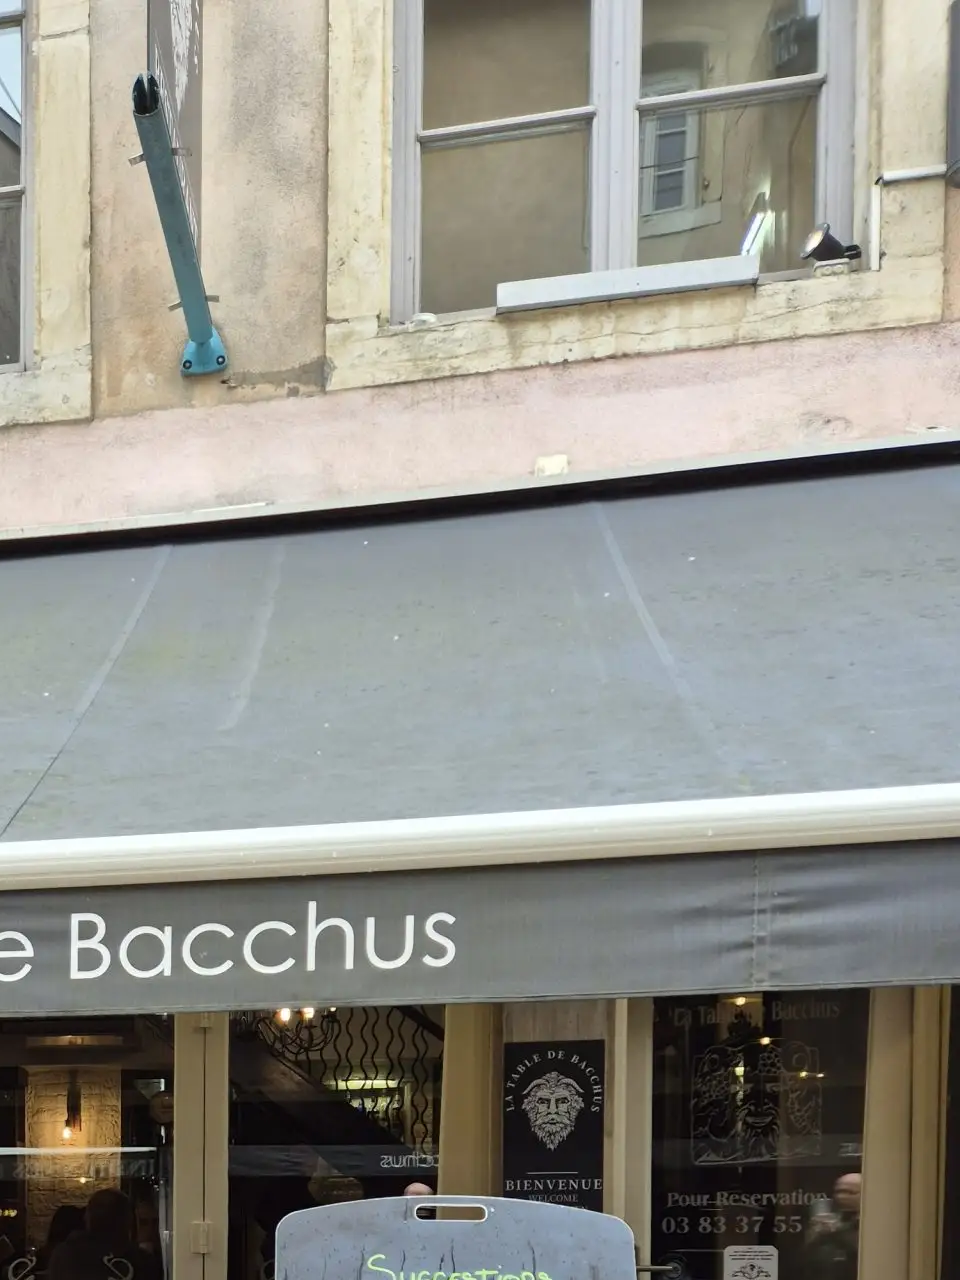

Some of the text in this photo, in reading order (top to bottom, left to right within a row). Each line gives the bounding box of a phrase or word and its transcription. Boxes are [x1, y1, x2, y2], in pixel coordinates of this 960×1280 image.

[69, 900, 456, 980] Bacchus
[505, 1050, 604, 1113] LA TABLE DE BACCHUS
[505, 1178, 603, 1192] BIENVENUE
[529, 1194, 578, 1203] WELCOME
[667, 1189, 828, 1208] Pour Reservation
[661, 1216, 690, 1234] 03
[698, 1216, 727, 1234] 83
[735, 1216, 764, 1234] 37
[773, 1216, 802, 1233] 55
